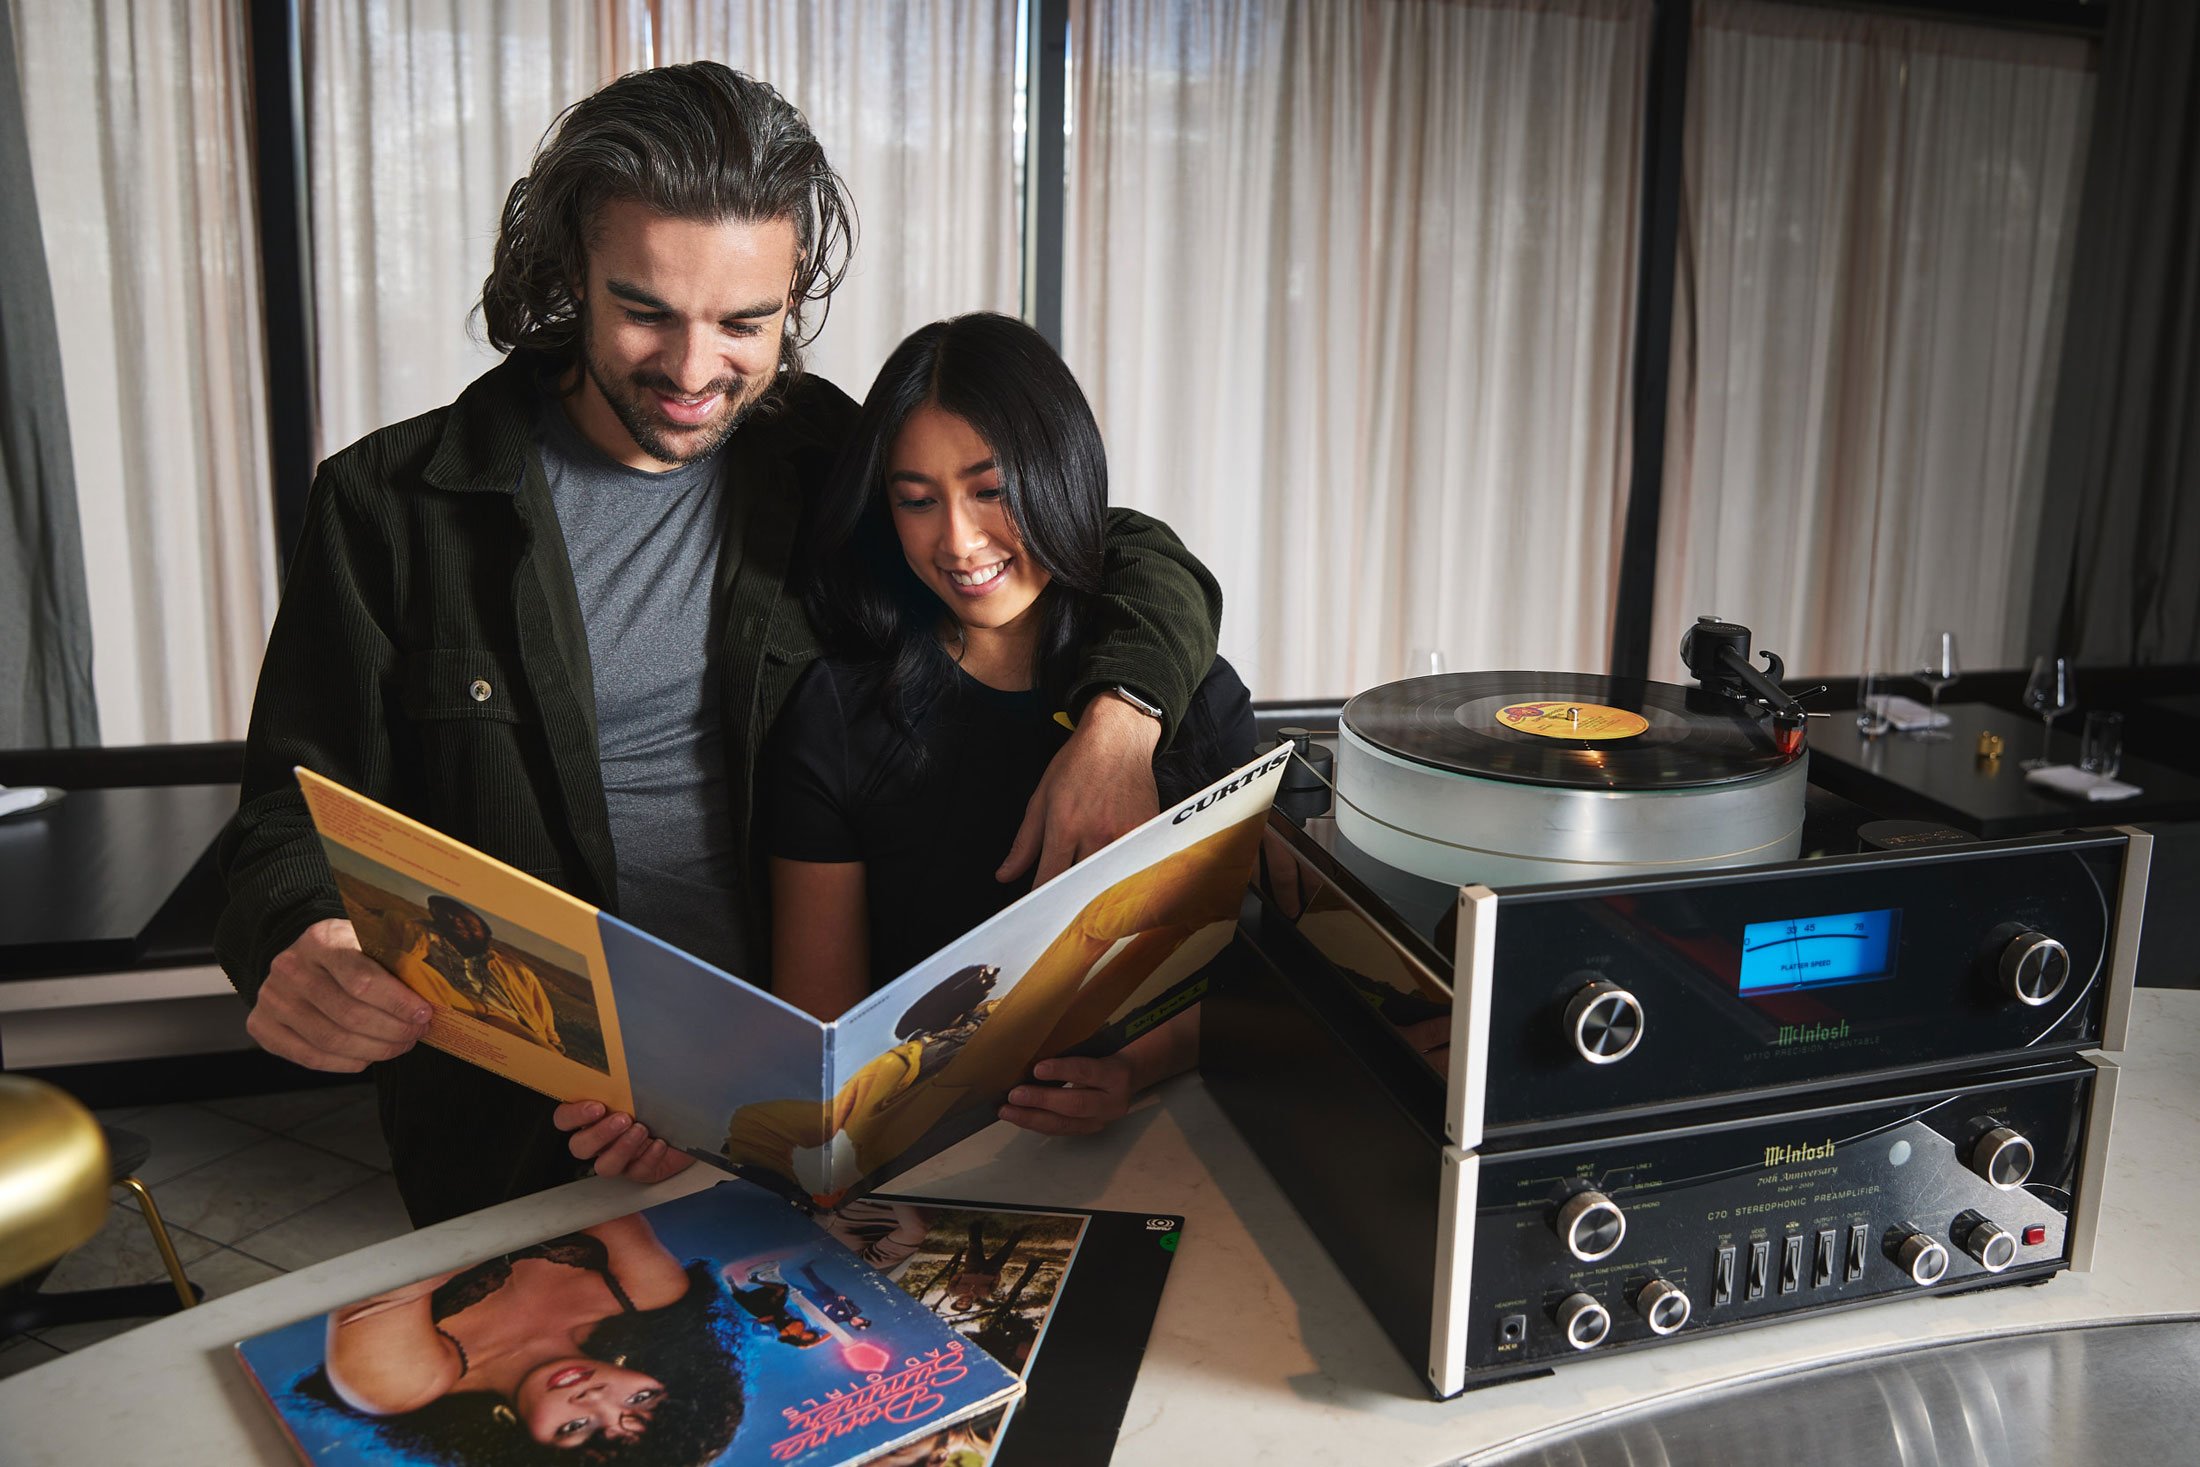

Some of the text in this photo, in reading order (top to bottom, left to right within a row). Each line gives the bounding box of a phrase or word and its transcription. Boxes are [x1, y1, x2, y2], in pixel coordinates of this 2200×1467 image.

[1172, 750, 1290, 825] CURTIS
[1786, 922, 1865, 935] 33 45 78
[1780, 959, 1831, 971] PLATTER SPEED
[1778, 1018, 1850, 1046] McIntosh
[1774, 1044, 1824, 1058] PRECISION
[1829, 1035, 1881, 1050] TURNTABLE
[1764, 1138, 1836, 1168] McIntosh
[1576, 1163, 1595, 1172] INPUT
[1757, 1165, 1839, 1188] 70th Anniversary
[1707, 1184, 1880, 1221] C70 STEREOPHONIC PREAMPLIFIER
[1595, 1266, 1609, 1275] TONE
[1611, 1262, 1639, 1273] CONTROLS
[1648, 1258, 1668, 1267] TREBLE
[782, 1340, 966, 1423] BAD GIRLS
[788, 1351, 969, 1430] Summer
[771, 1385, 945, 1461] Donna
